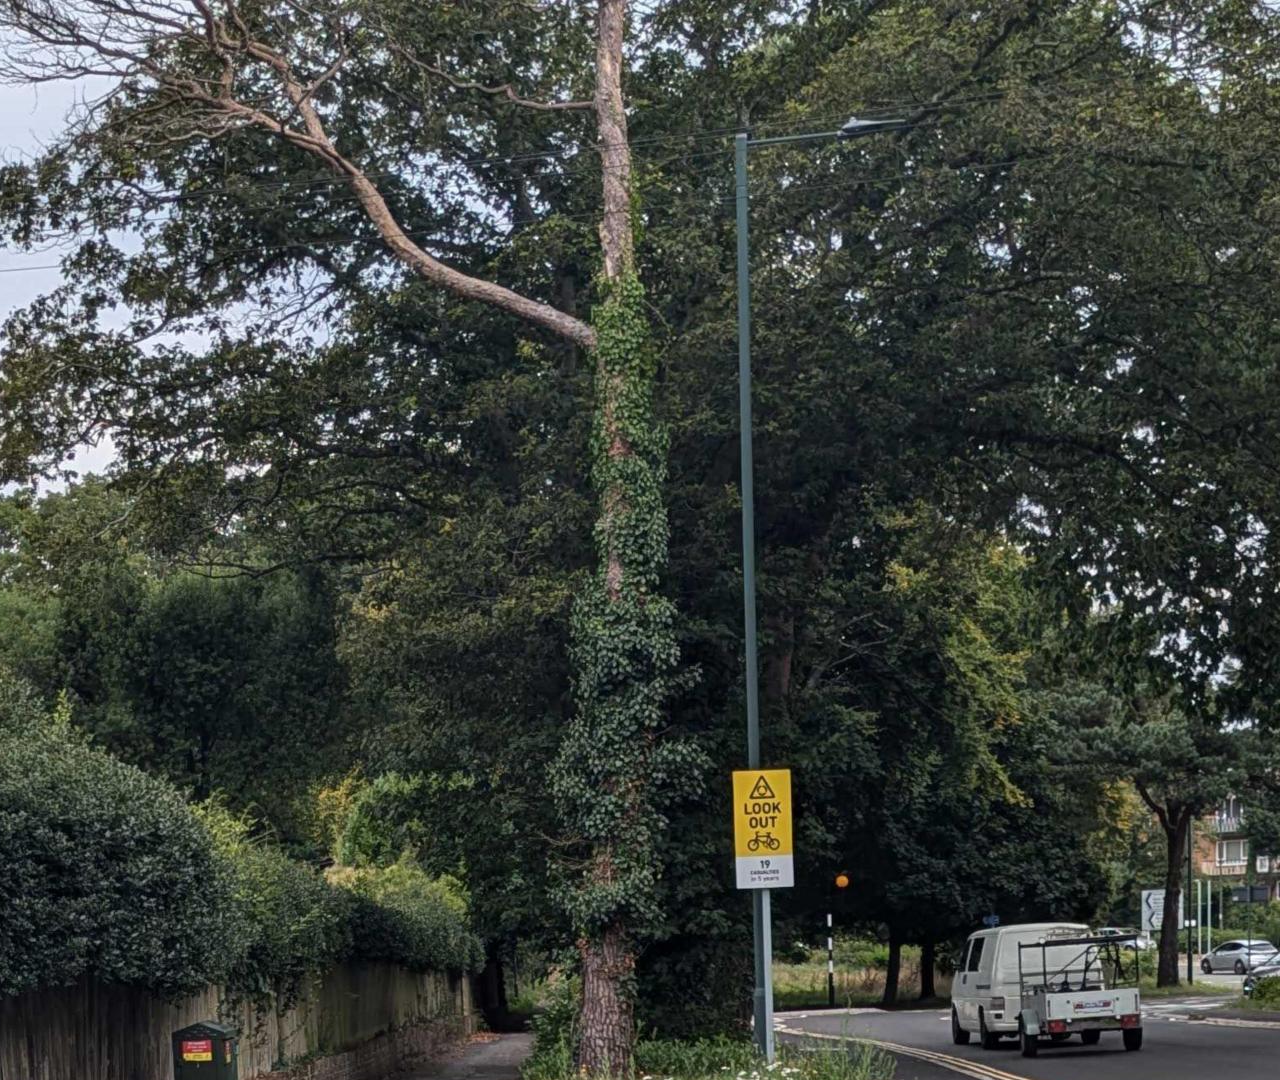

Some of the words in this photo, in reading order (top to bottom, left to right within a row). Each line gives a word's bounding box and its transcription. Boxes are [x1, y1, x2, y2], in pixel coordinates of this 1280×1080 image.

[744, 802, 782, 815] LOOK
[749, 816, 777, 829] OUT
[760, 860, 771, 869] 19
